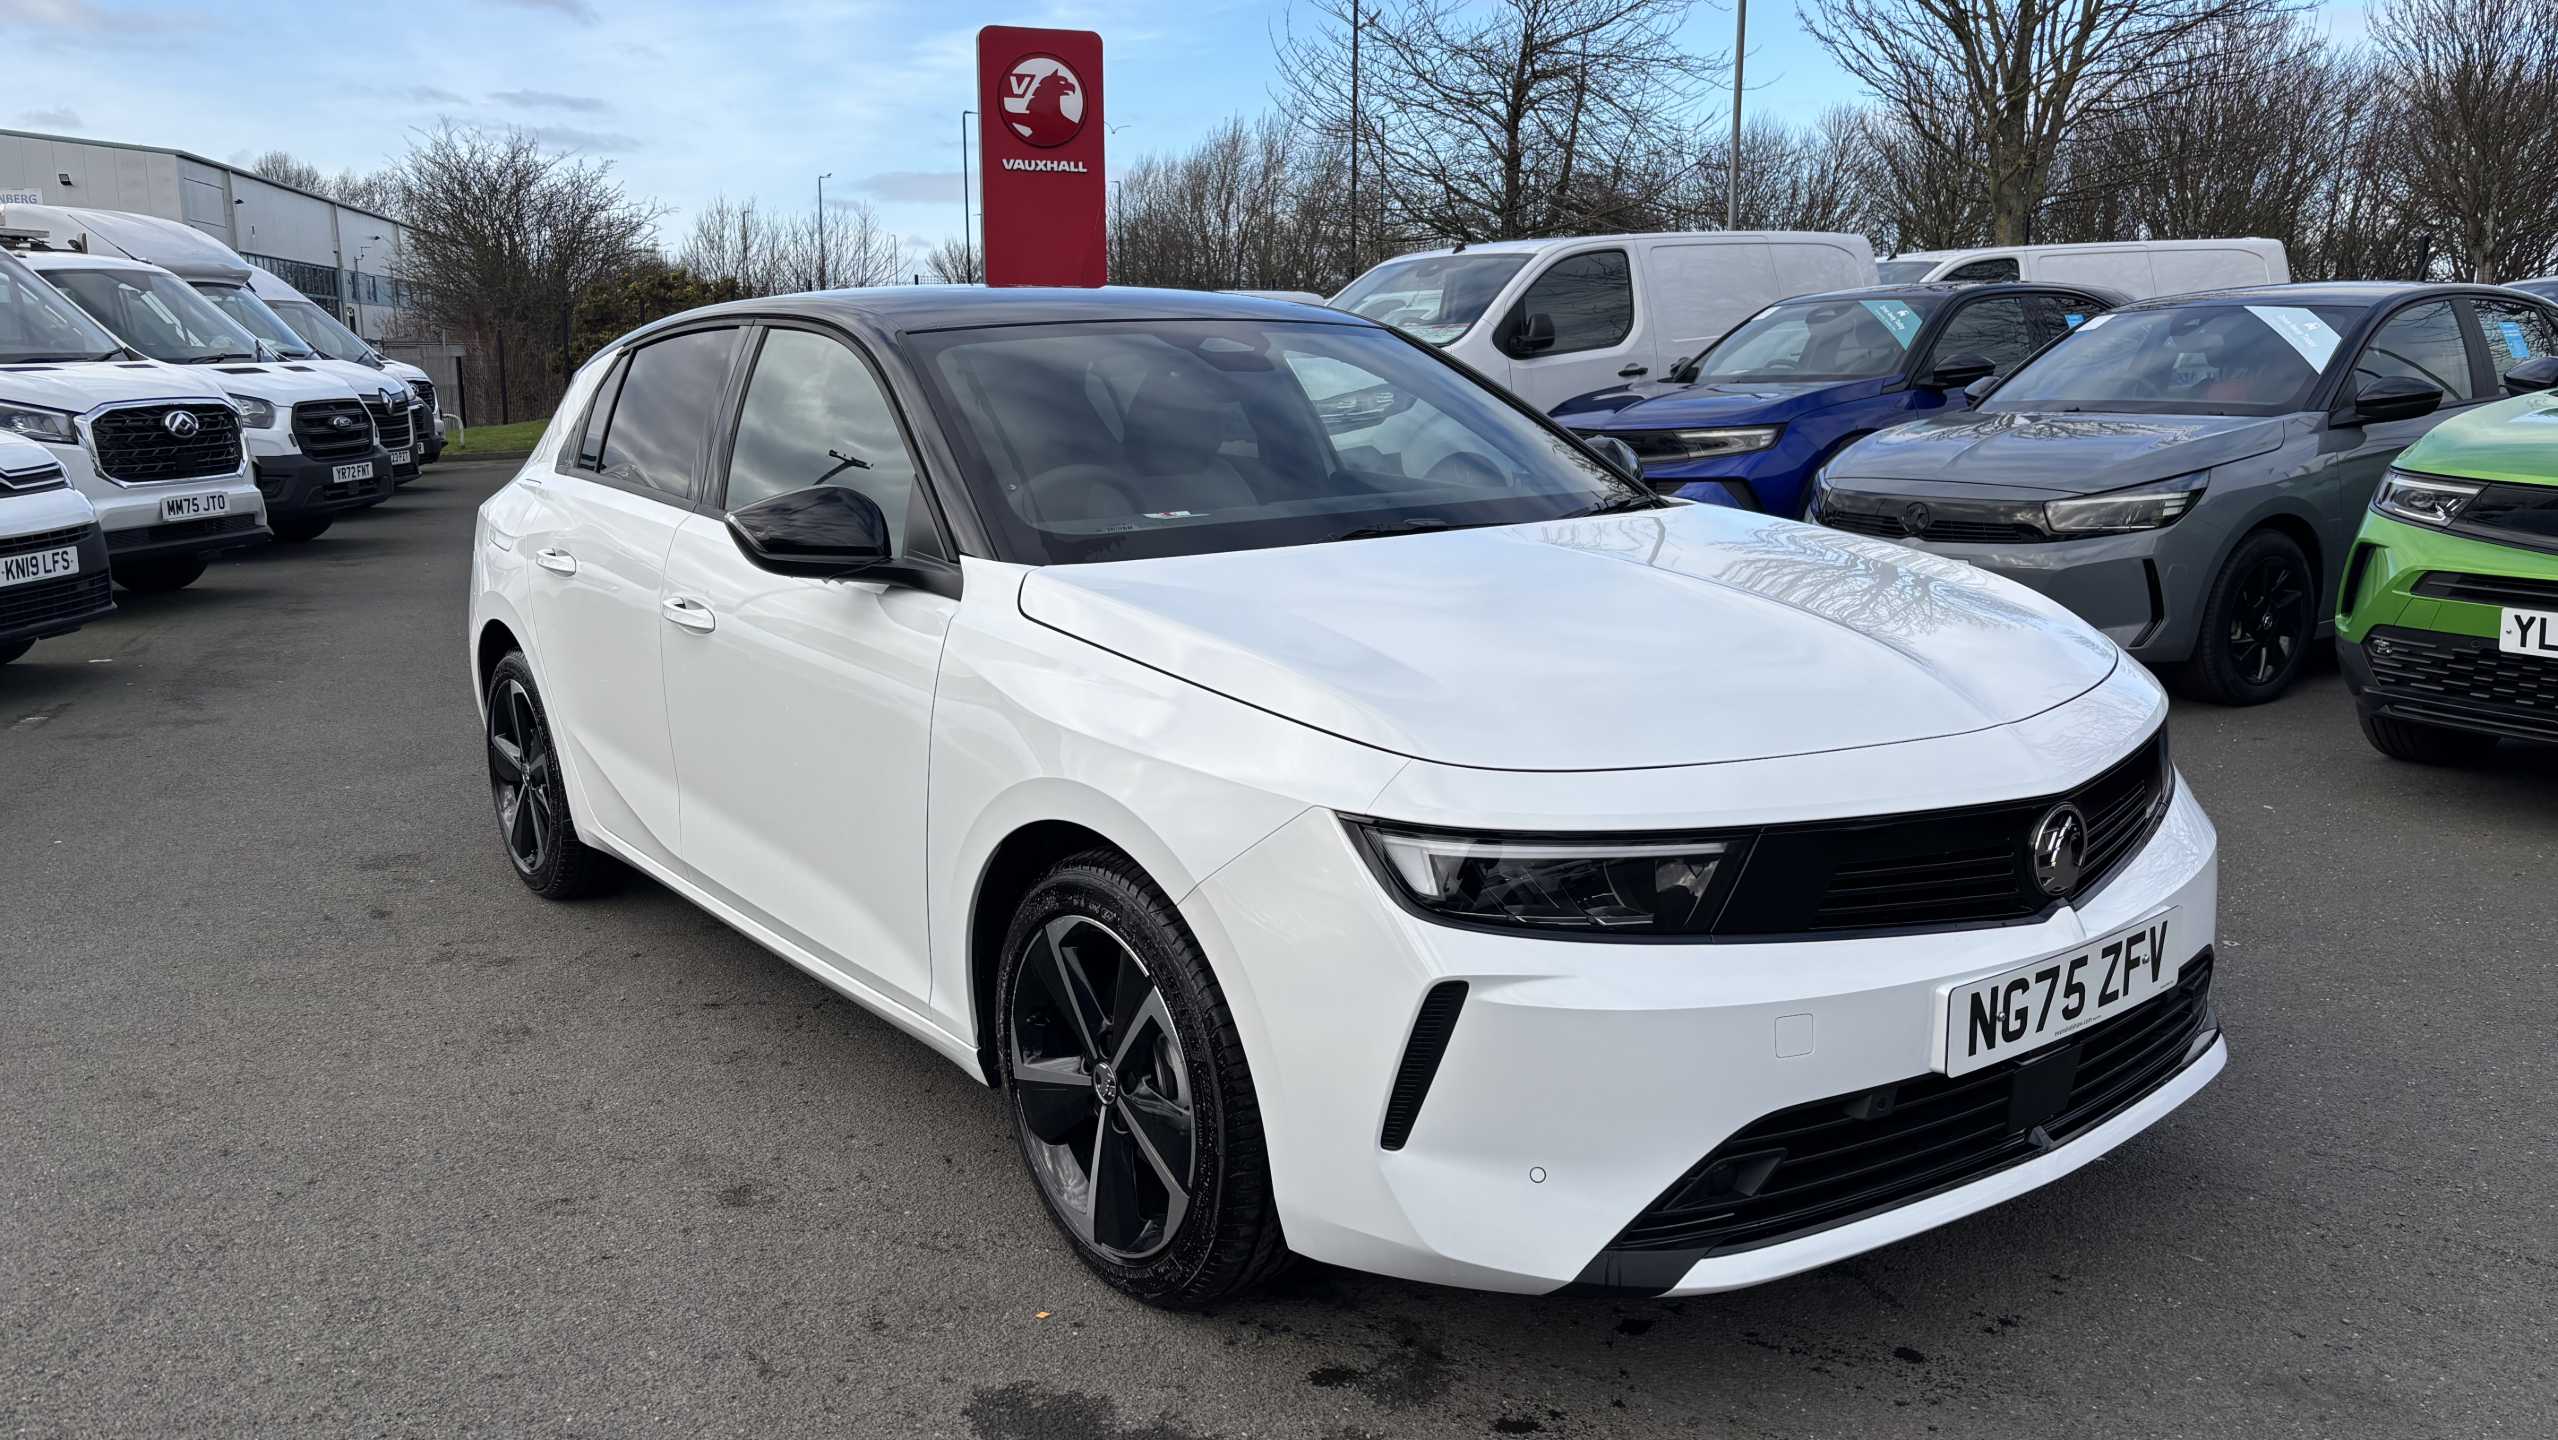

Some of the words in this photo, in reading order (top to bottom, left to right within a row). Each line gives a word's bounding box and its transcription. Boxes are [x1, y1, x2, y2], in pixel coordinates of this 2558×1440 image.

[1002, 158, 1088, 173] VAUXHALL
[336, 465, 356, 480] YR72
[166, 497, 200, 516] MM75
[203, 494, 226, 511] JTO
[5, 556, 40, 581] KN19
[42, 550, 70, 574] LFS
[2513, 614, 2558, 651] YL
[1968, 954, 2089, 1057] NG75
[2097, 920, 2168, 1008] ZFV
